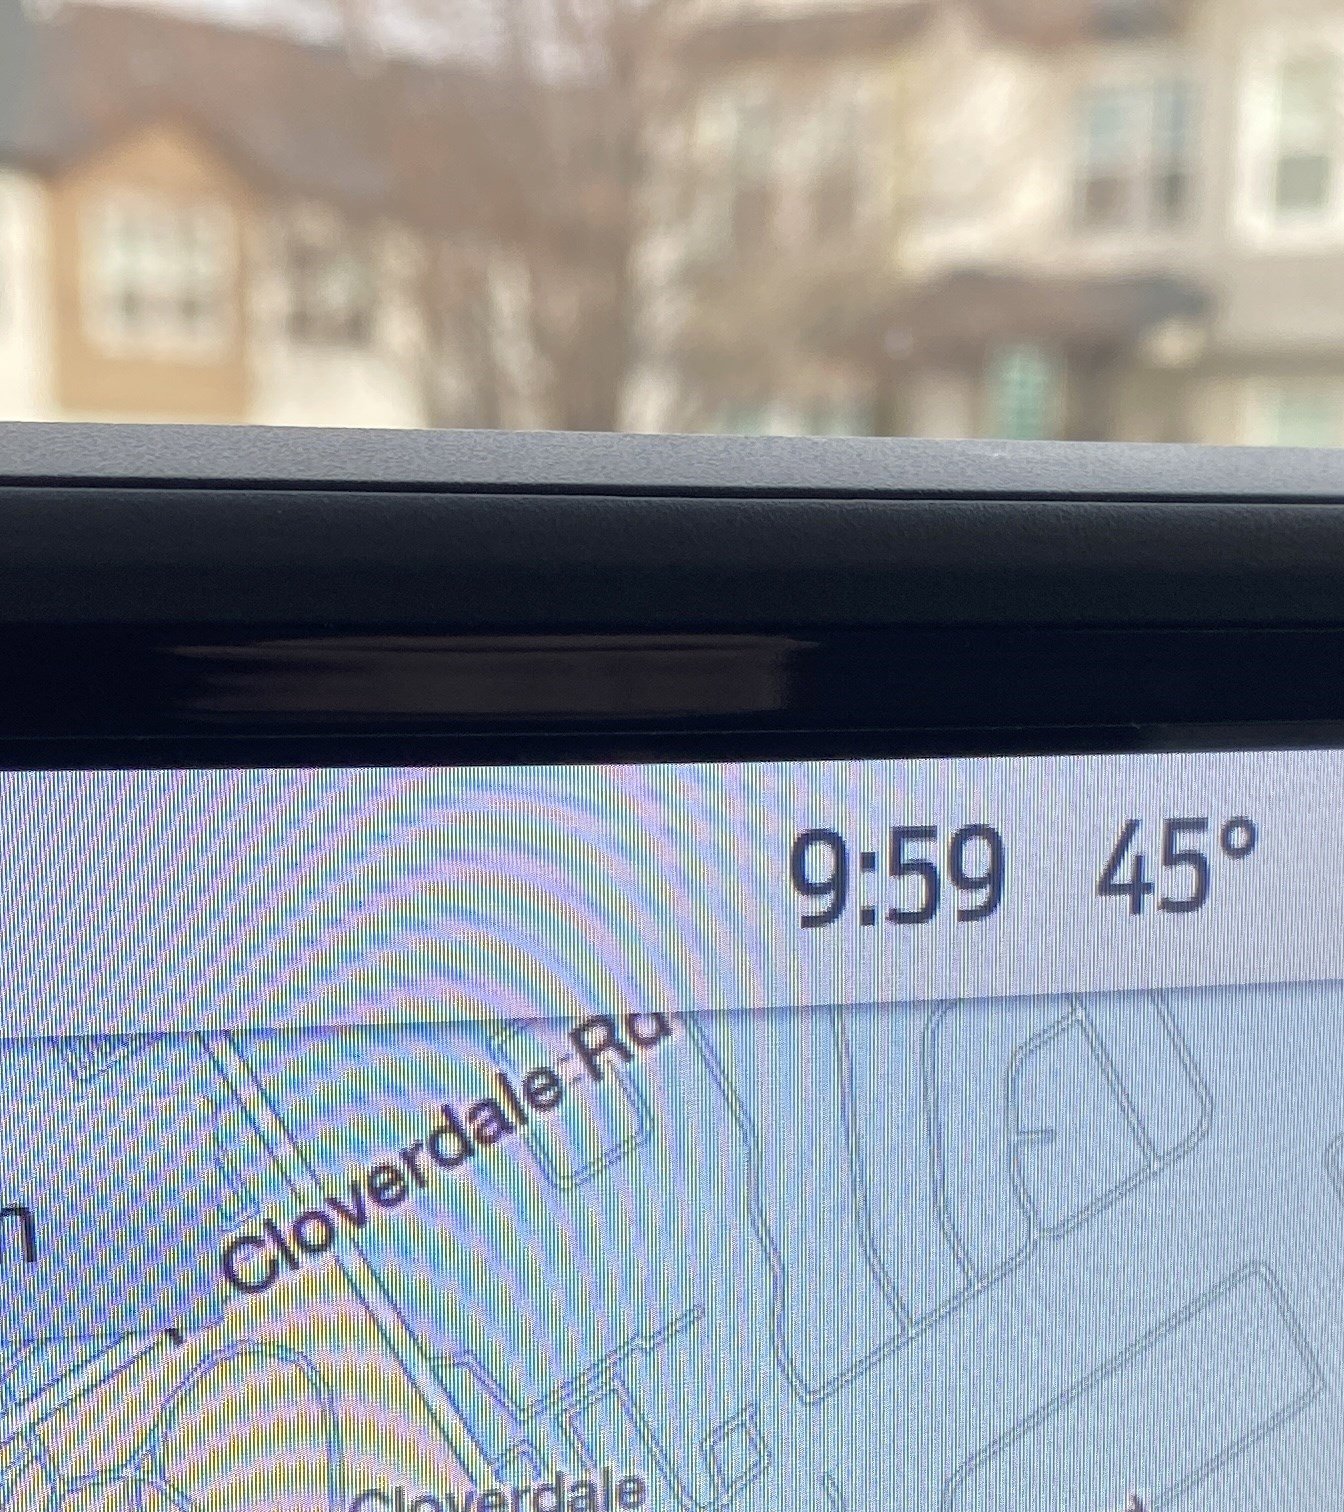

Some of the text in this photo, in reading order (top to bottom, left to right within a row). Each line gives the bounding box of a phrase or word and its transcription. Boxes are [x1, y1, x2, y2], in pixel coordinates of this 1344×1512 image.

[790, 822, 1006, 928] 9:59
[1096, 815, 1258, 916] 45°
[218, 1059, 567, 1297] Cloverdale
